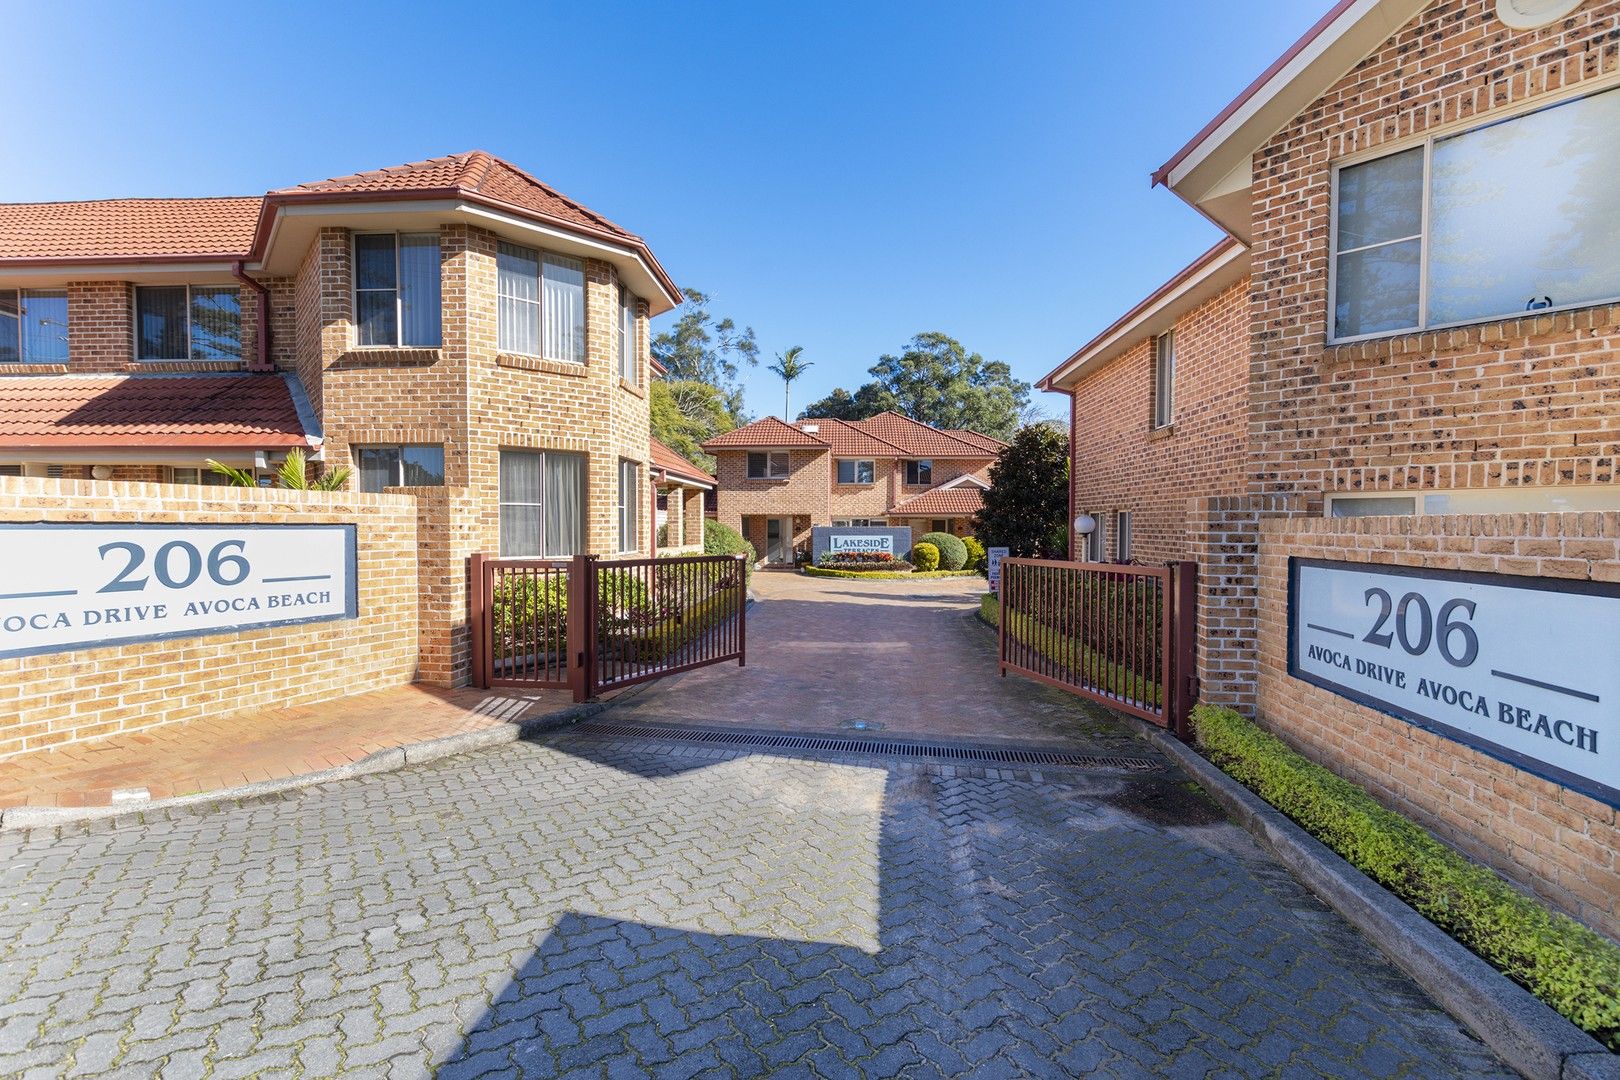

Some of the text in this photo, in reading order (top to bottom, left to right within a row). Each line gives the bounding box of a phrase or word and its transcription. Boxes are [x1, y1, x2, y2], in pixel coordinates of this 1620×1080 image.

[95, 540, 251, 594] 206
[833, 537, 890, 549] LAKESIDE
[0, 591, 331, 632] OCA DRIVE AVOCA BEACH
[1362, 586, 1479, 668] 206
[1307, 643, 1599, 755] AVOCA DRIVE AVOCA BEACH
